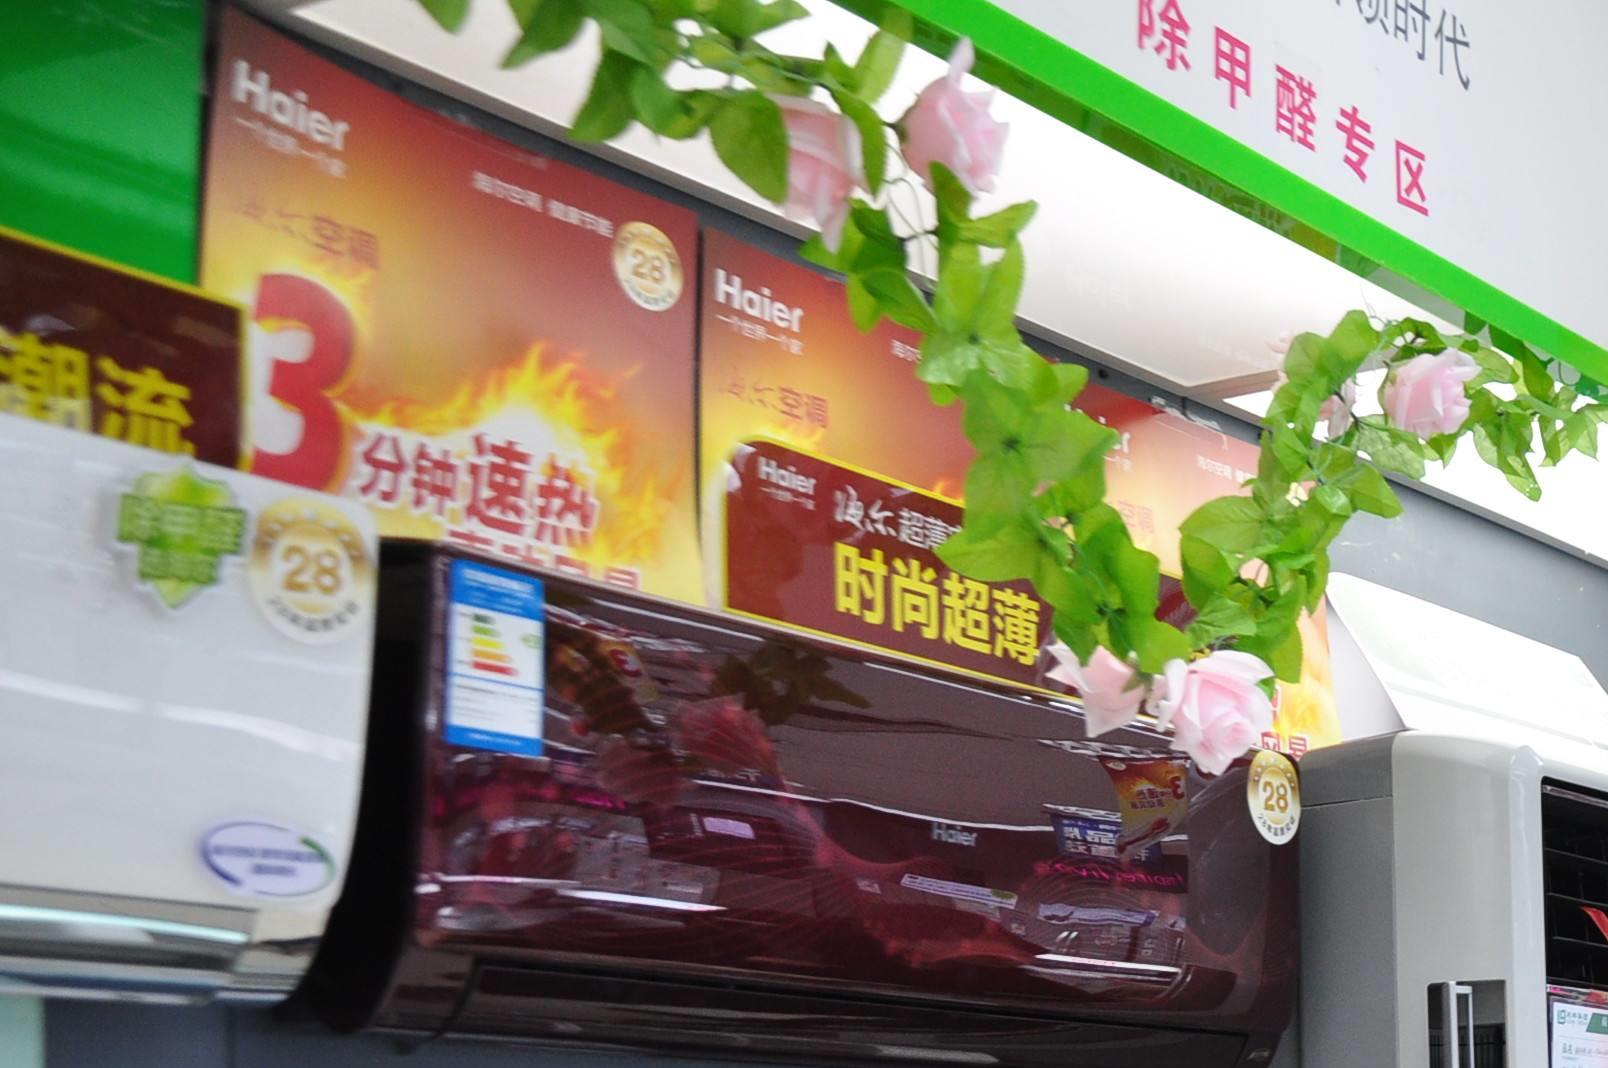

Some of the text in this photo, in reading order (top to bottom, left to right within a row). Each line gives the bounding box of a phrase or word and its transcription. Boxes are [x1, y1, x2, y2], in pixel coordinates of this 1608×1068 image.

[236, 59, 350, 151] Haier
[1137, 0, 1430, 217] 除甲醛专区
[714, 269, 803, 333] Haier
[252, 271, 356, 492] 3
[359, 432, 597, 547] 分钟速热
[758, 456, 817, 496] Haier
[282, 544, 342, 596] 28
[834, 541, 1041, 666] 时尚超薄
[1262, 780, 1289, 814] 28
[932, 822, 979, 847] Haier
